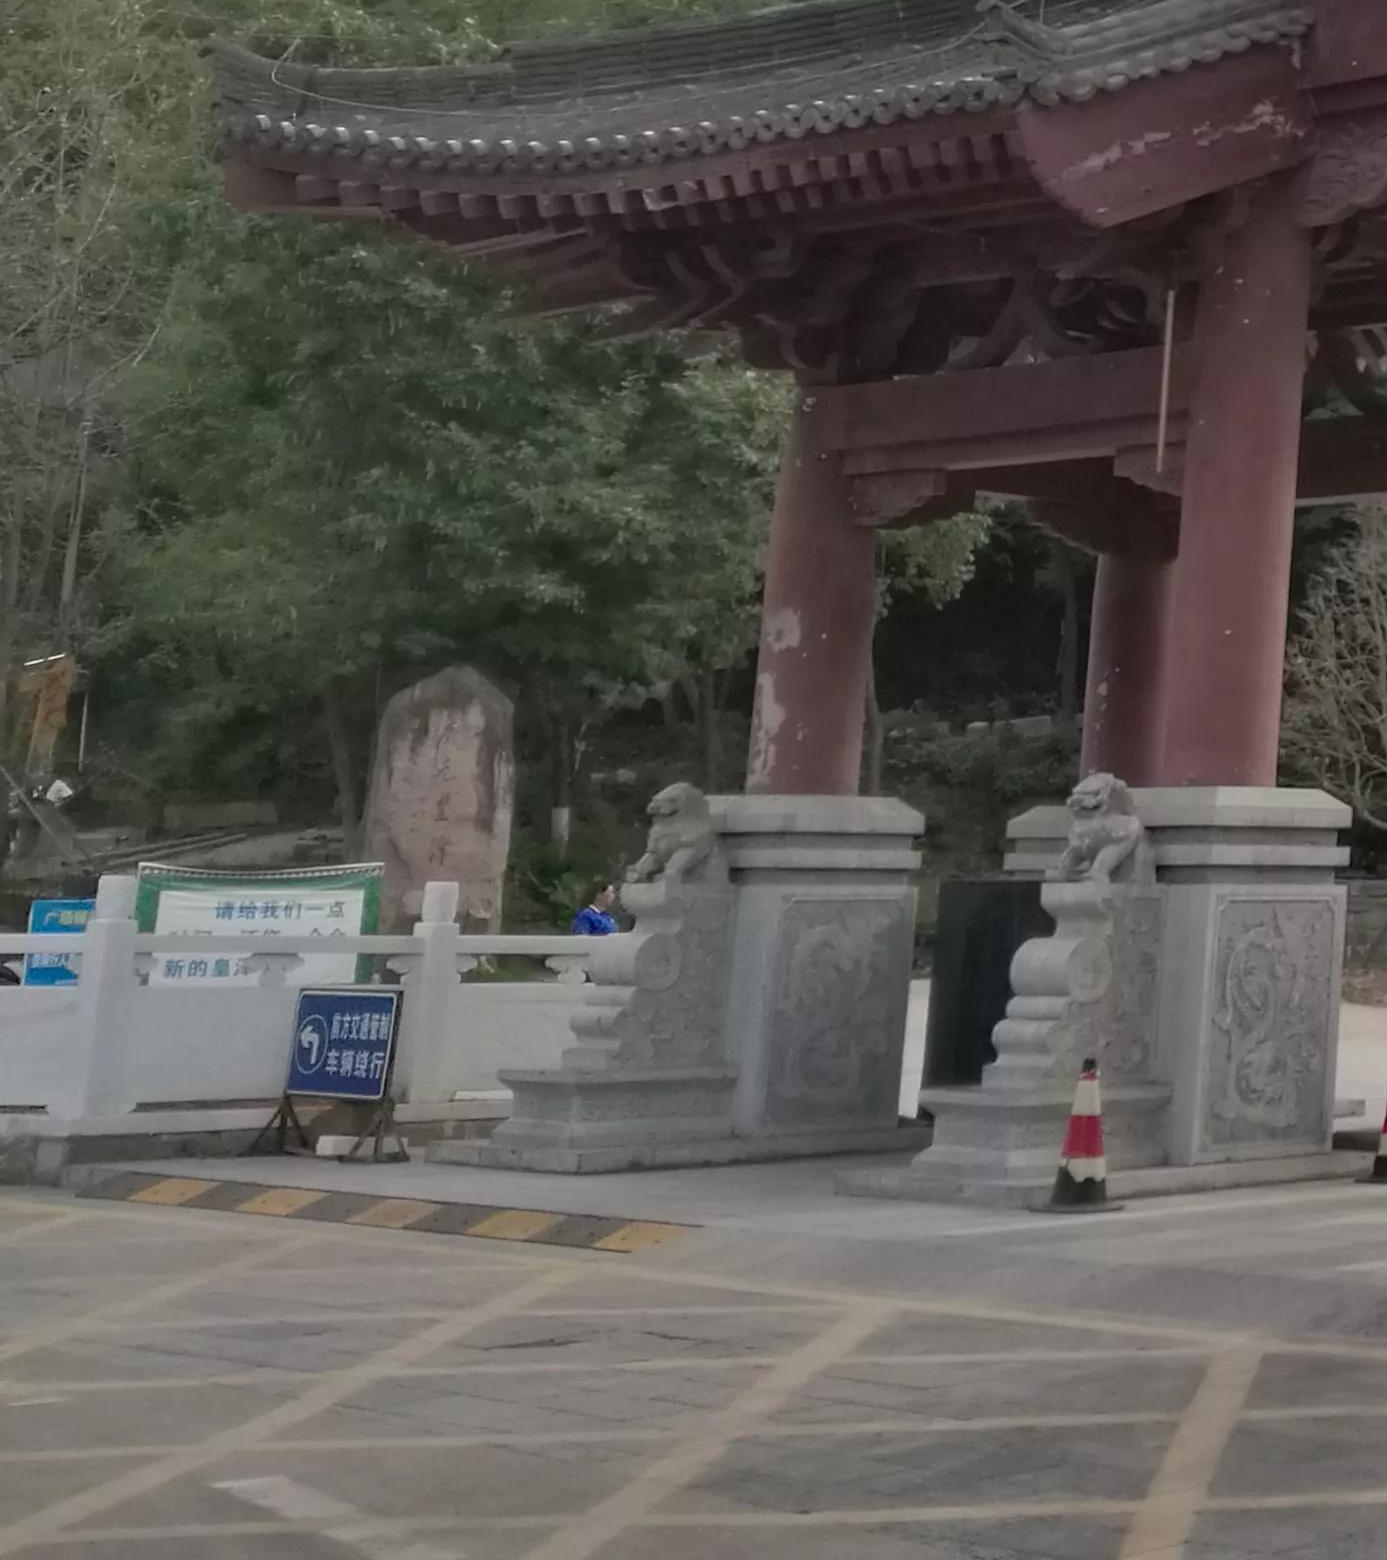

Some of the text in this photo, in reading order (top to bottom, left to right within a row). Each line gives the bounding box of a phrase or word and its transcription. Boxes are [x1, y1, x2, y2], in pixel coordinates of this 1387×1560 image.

[213, 900, 346, 920] 请给我们一点
[325, 1048, 386, 1080] 车辆绕行
